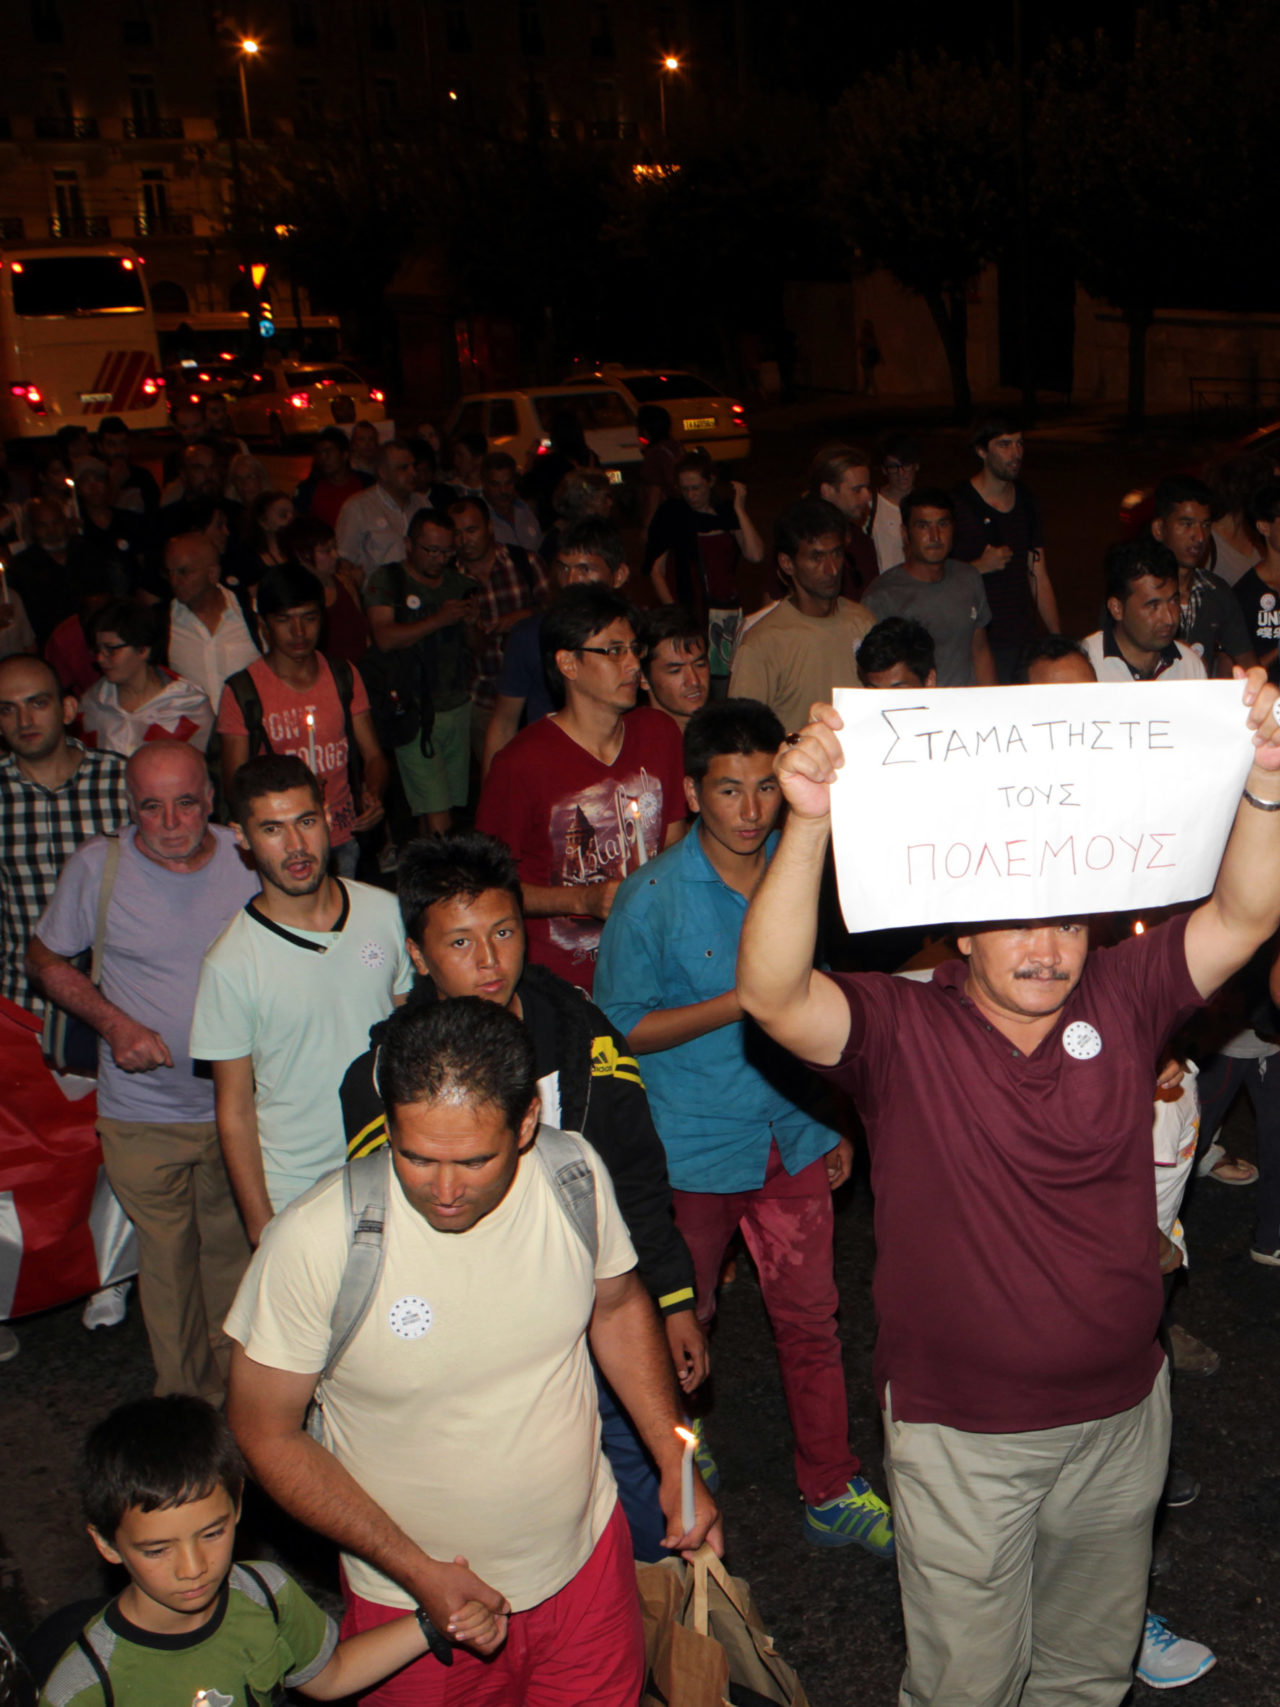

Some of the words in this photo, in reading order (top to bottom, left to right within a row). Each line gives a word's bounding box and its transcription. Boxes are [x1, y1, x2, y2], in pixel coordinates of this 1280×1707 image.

[881, 705, 1174, 766] ΣΤΑΜΑΤΗΣΤΕ
[998, 783, 1081, 808] ΤΟΥΣ
[906, 833, 1177, 885] ΠΟΛΕΜΟΥΣ
